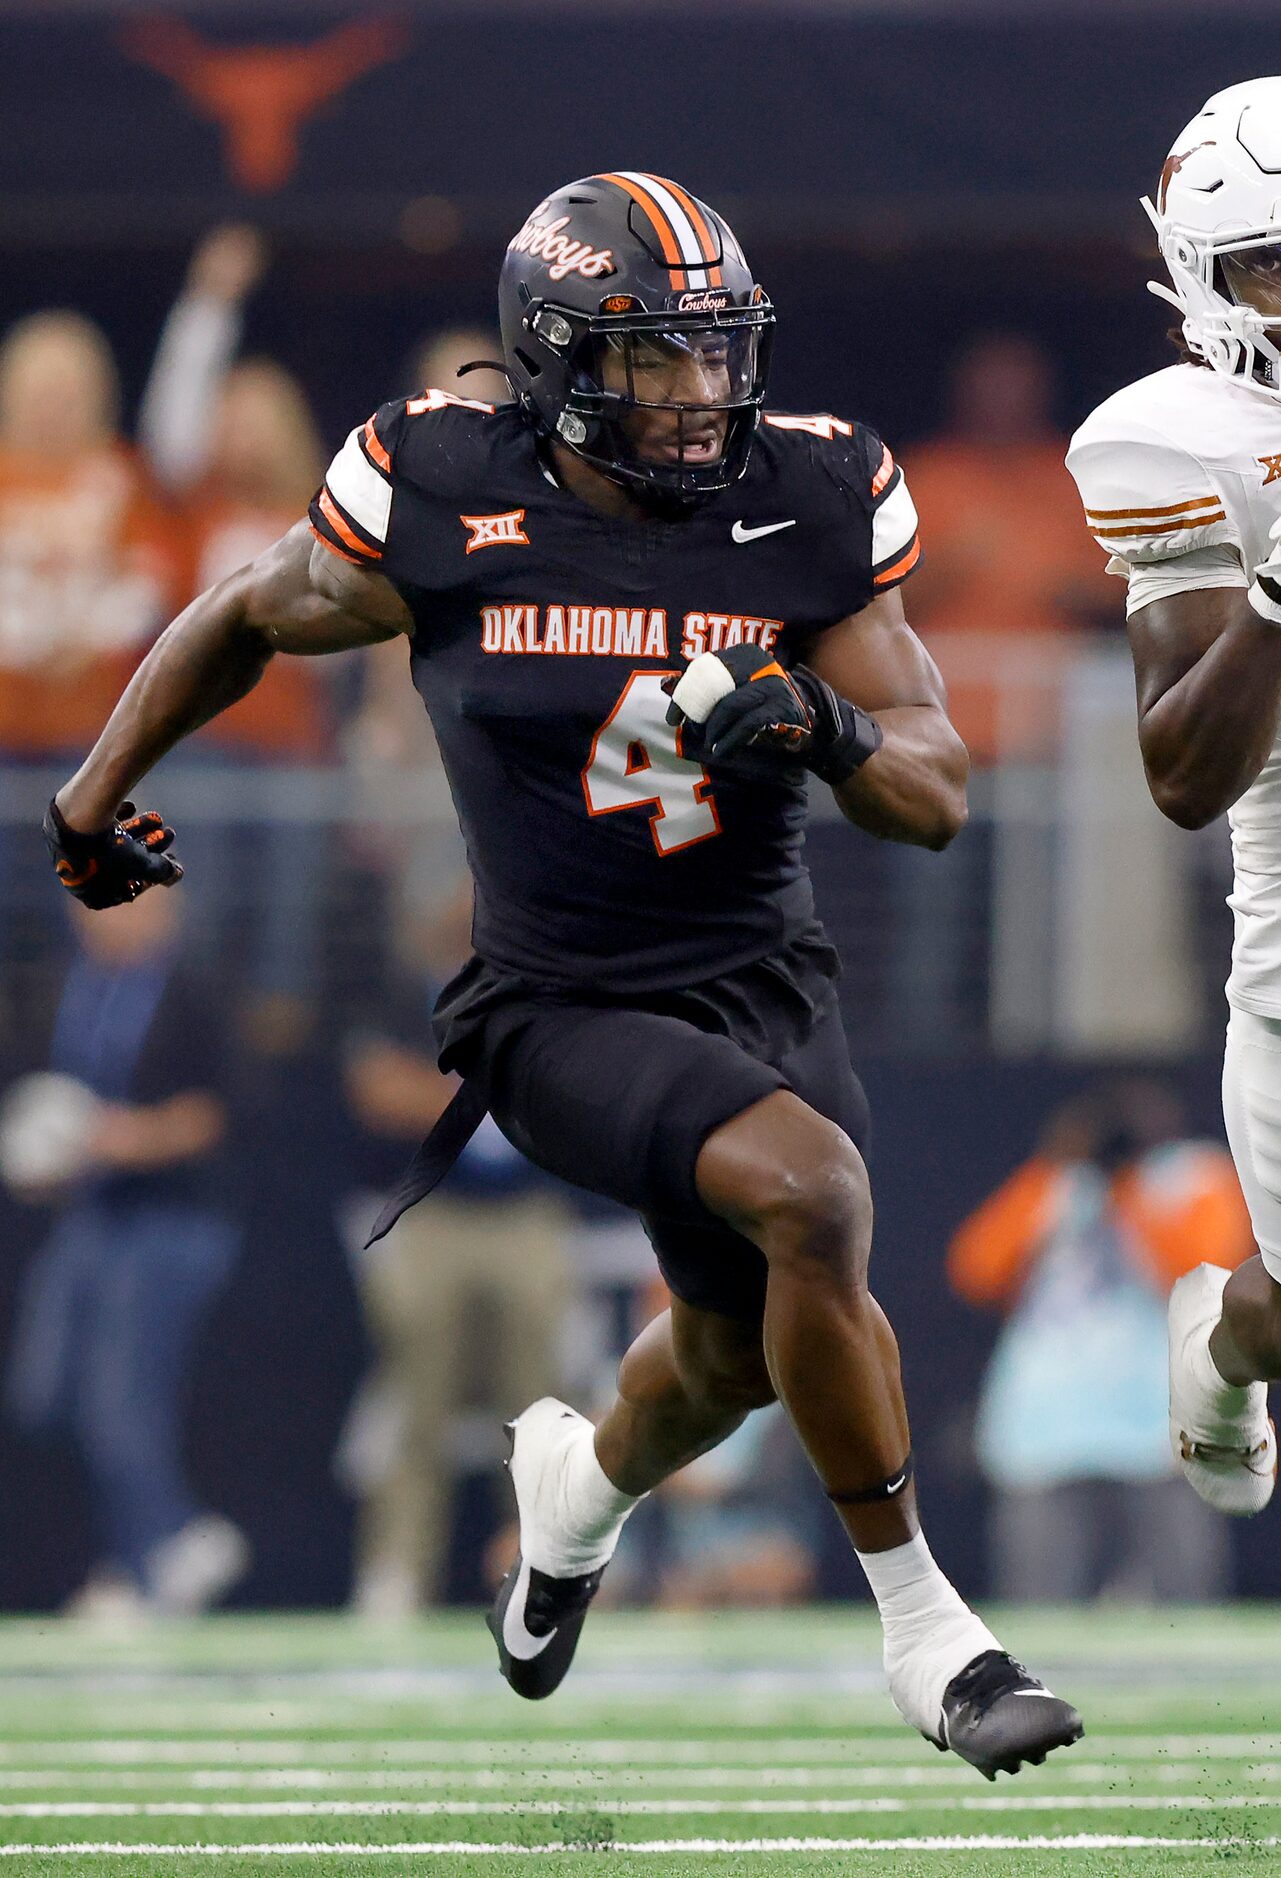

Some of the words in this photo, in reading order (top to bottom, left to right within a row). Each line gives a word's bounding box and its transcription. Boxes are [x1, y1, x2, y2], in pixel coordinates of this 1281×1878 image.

[678, 292, 727, 312] Cowboys
[460, 508, 531, 555] XII
[480, 604, 669, 659] OKLAHOMA
[580, 669, 724, 858] 4
